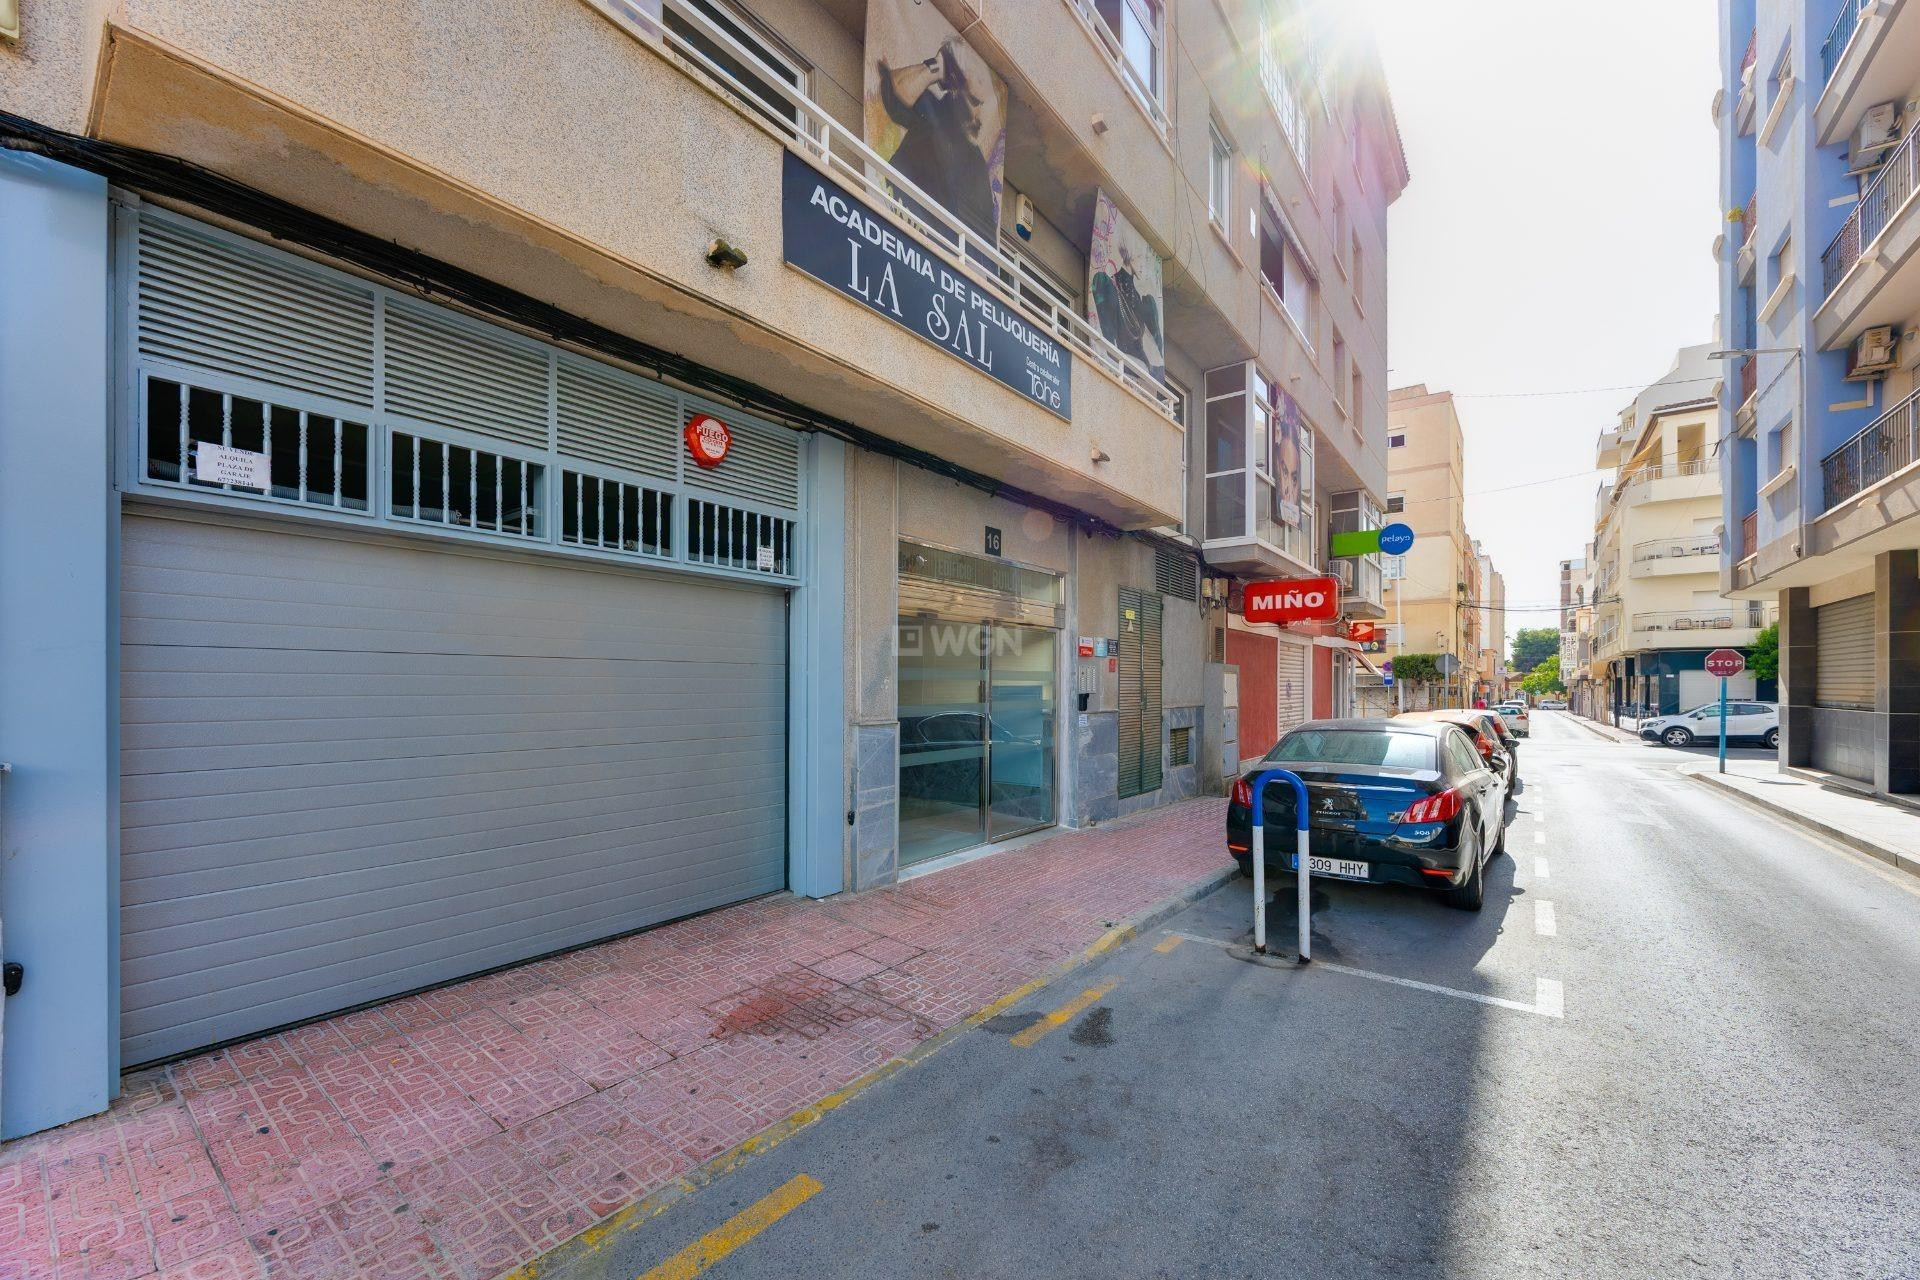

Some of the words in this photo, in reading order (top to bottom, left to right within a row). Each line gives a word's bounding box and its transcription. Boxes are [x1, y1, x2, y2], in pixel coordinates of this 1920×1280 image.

[810, 185, 936, 284] ACADEMIA
[940, 270, 966, 303] DE
[971, 292, 1060, 368] PELUQUERÍA
[847, 237, 903, 318] LA
[926, 293, 993, 371] SAL
[696, 425, 728, 443] FUEGO
[217, 462, 243, 471] PLAZA
[220, 470, 250, 479] GARAJE
[987, 533, 1000, 550] 16
[1381, 533, 1411, 545] pelayo
[1252, 589, 1325, 611] MIÑO
[1308, 858, 1332, 872] 309
[1339, 862, 1364, 876] HHY
